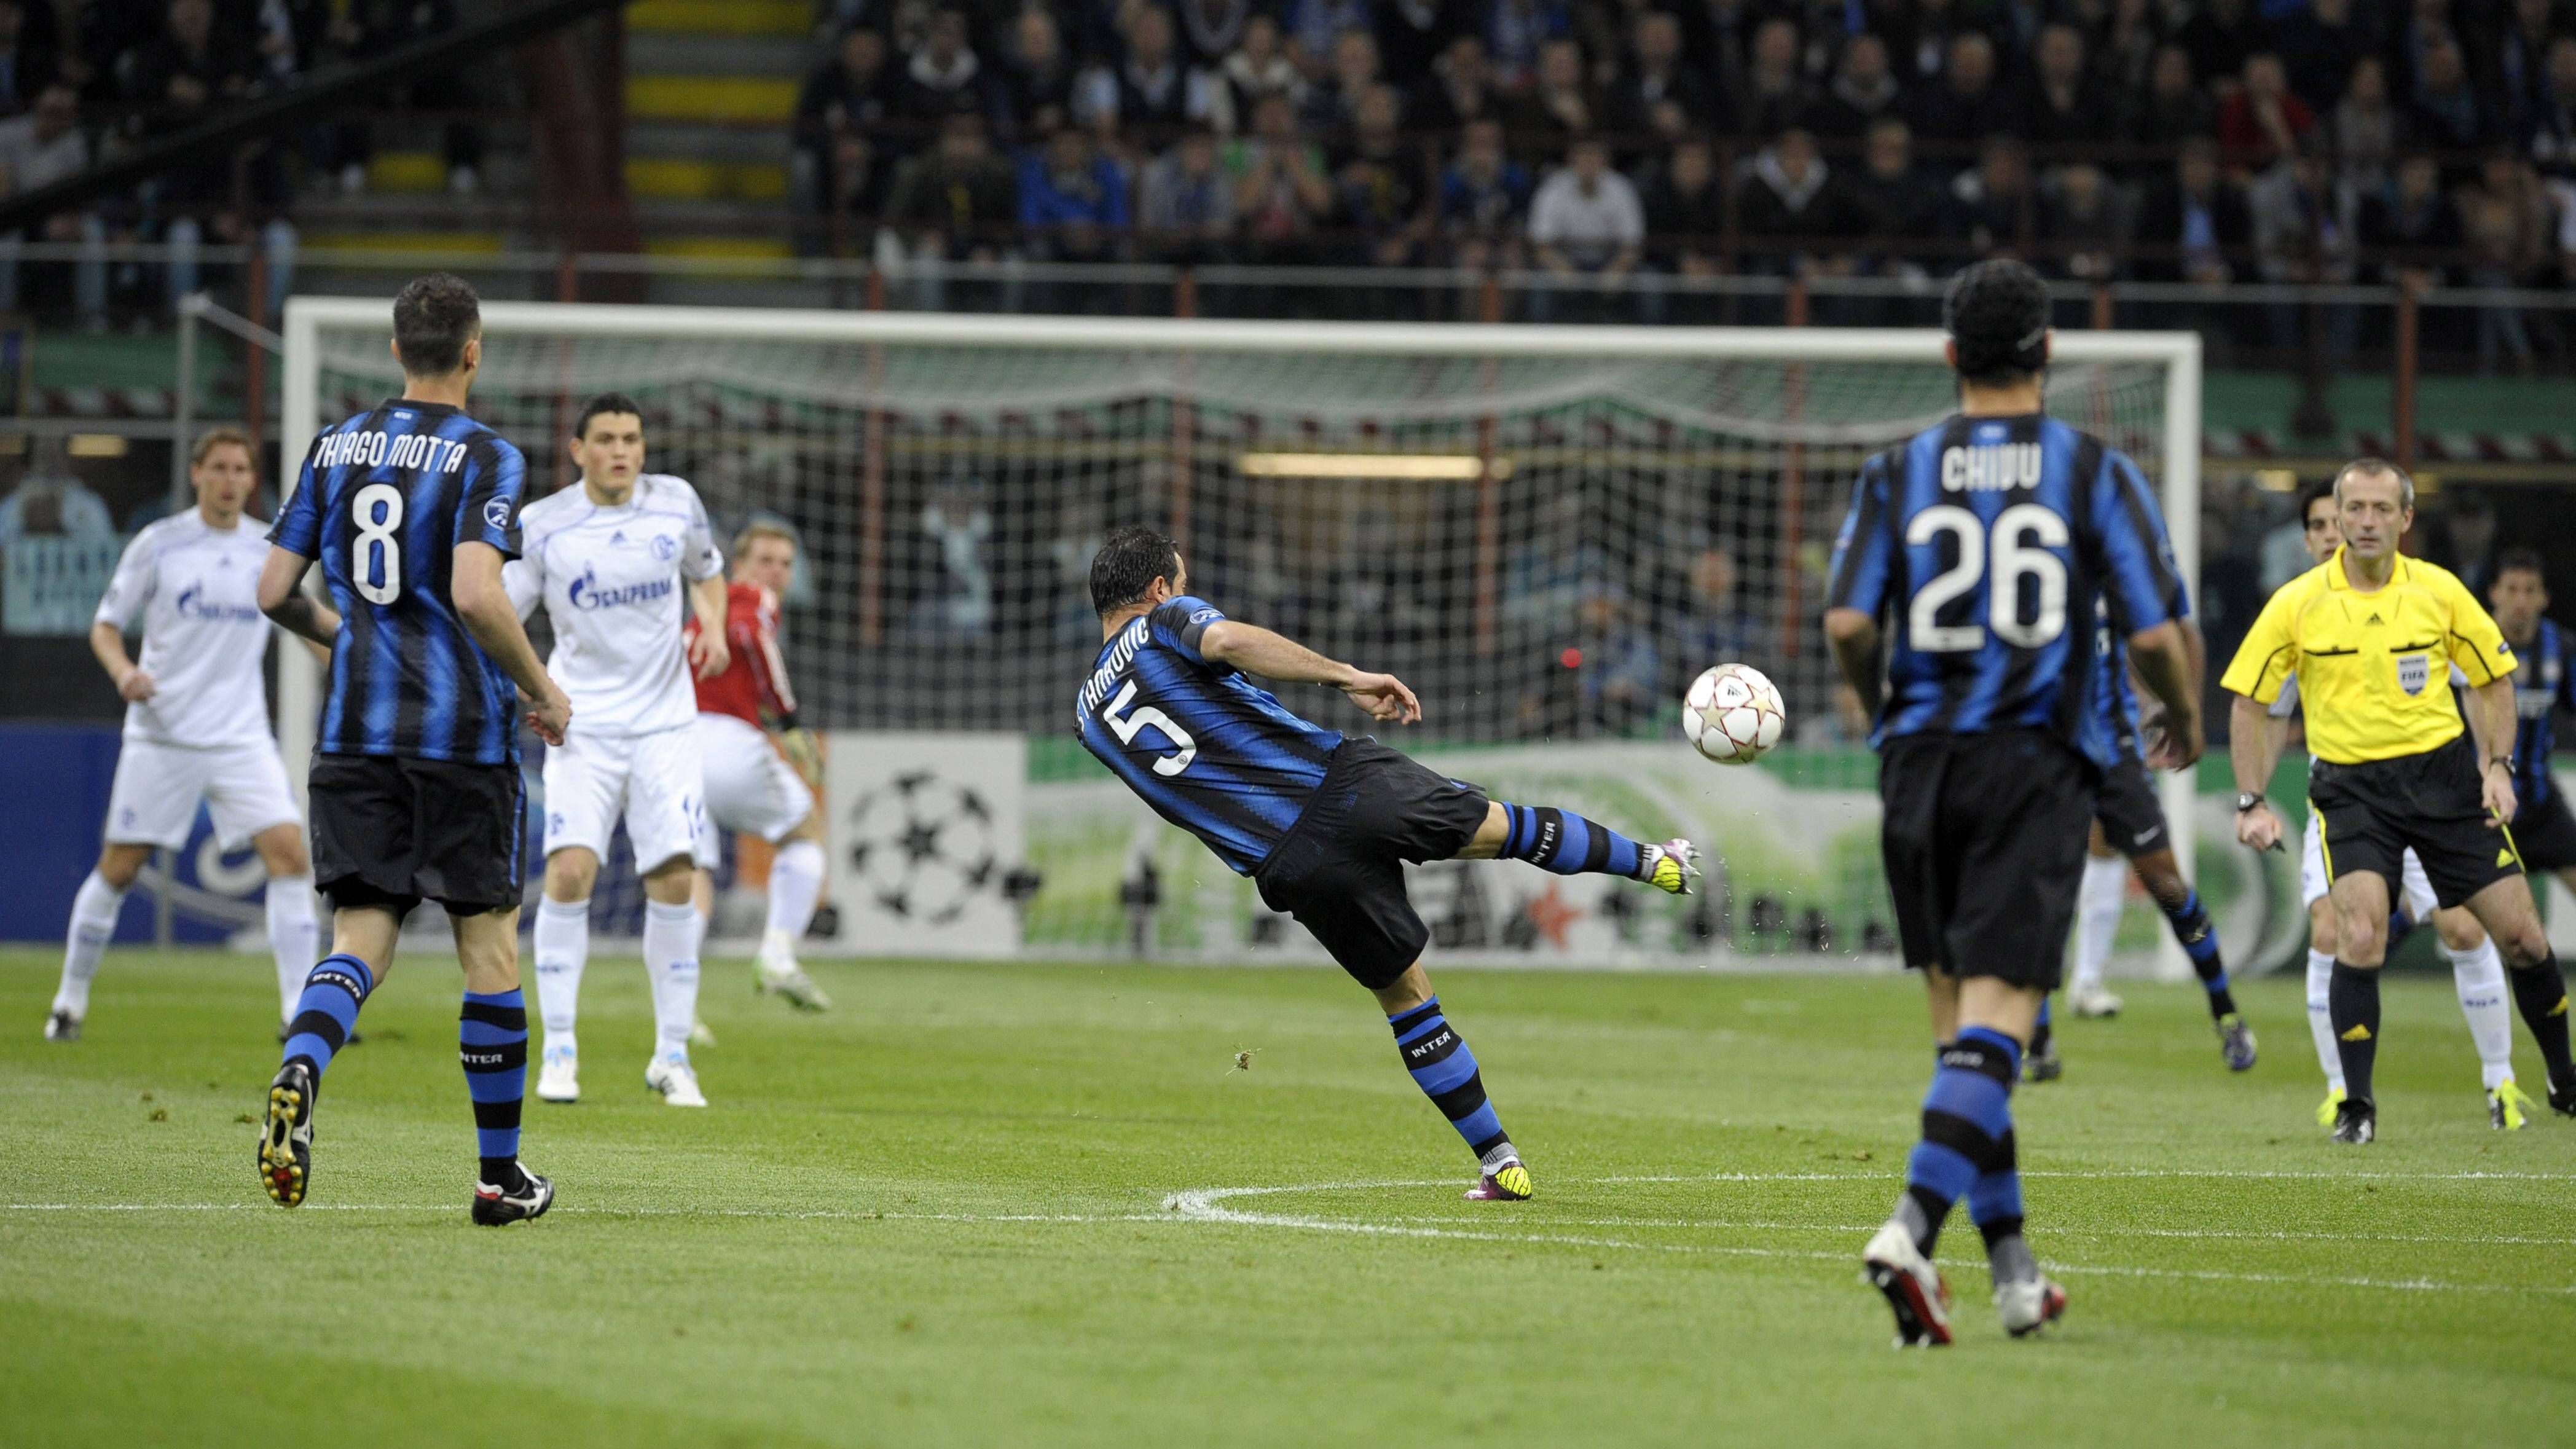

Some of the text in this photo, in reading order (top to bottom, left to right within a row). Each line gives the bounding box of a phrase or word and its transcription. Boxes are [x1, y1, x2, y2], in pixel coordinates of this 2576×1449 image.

[312, 430, 468, 473] THIAGO MOTTA
[1941, 442, 2043, 492] CHIVU
[352, 483, 404, 605] 8
[1906, 503, 2070, 653] 26
[1077, 616, 1149, 732] STANKOVIC
[1103, 678, 1197, 777] 5
[1531, 821, 1556, 863] INTER
[312, 972, 361, 999] INTER
[1411, 1031, 1451, 1058] INTER
